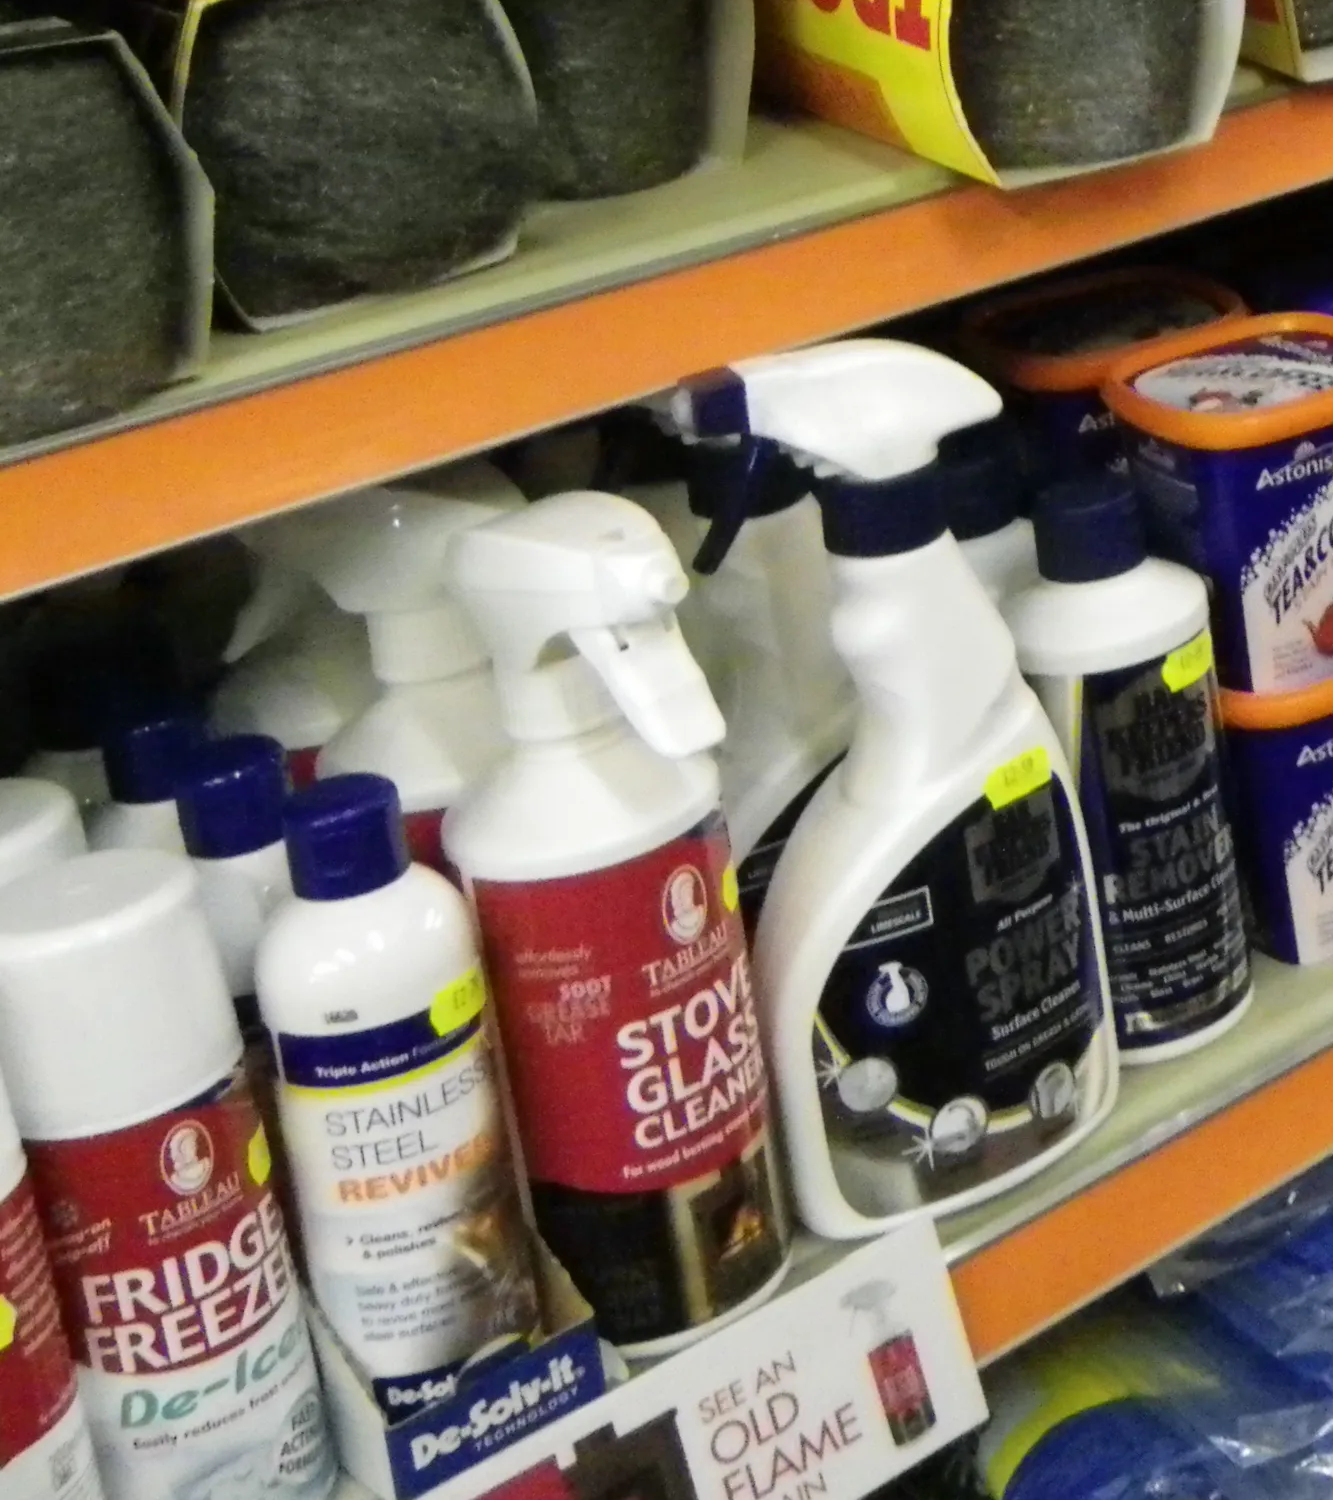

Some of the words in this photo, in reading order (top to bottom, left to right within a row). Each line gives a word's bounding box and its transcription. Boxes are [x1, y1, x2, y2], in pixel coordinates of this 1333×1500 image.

[616, 951, 750, 1070] STOVE
[314, 1062, 358, 1081] Triple
[360, 1049, 410, 1073] Action
[325, 1059, 488, 1138] STAINLESS
[331, 1134, 440, 1171] STEEL
[81, 1191, 284, 1326] FRIDGE
[473, 1385, 581, 1451] TECHNOLOGY
[698, 1376, 751, 1423] SEE
[755, 1350, 797, 1395] AN
[711, 1384, 800, 1465] OLD
[721, 1402, 864, 1500] FLAME
